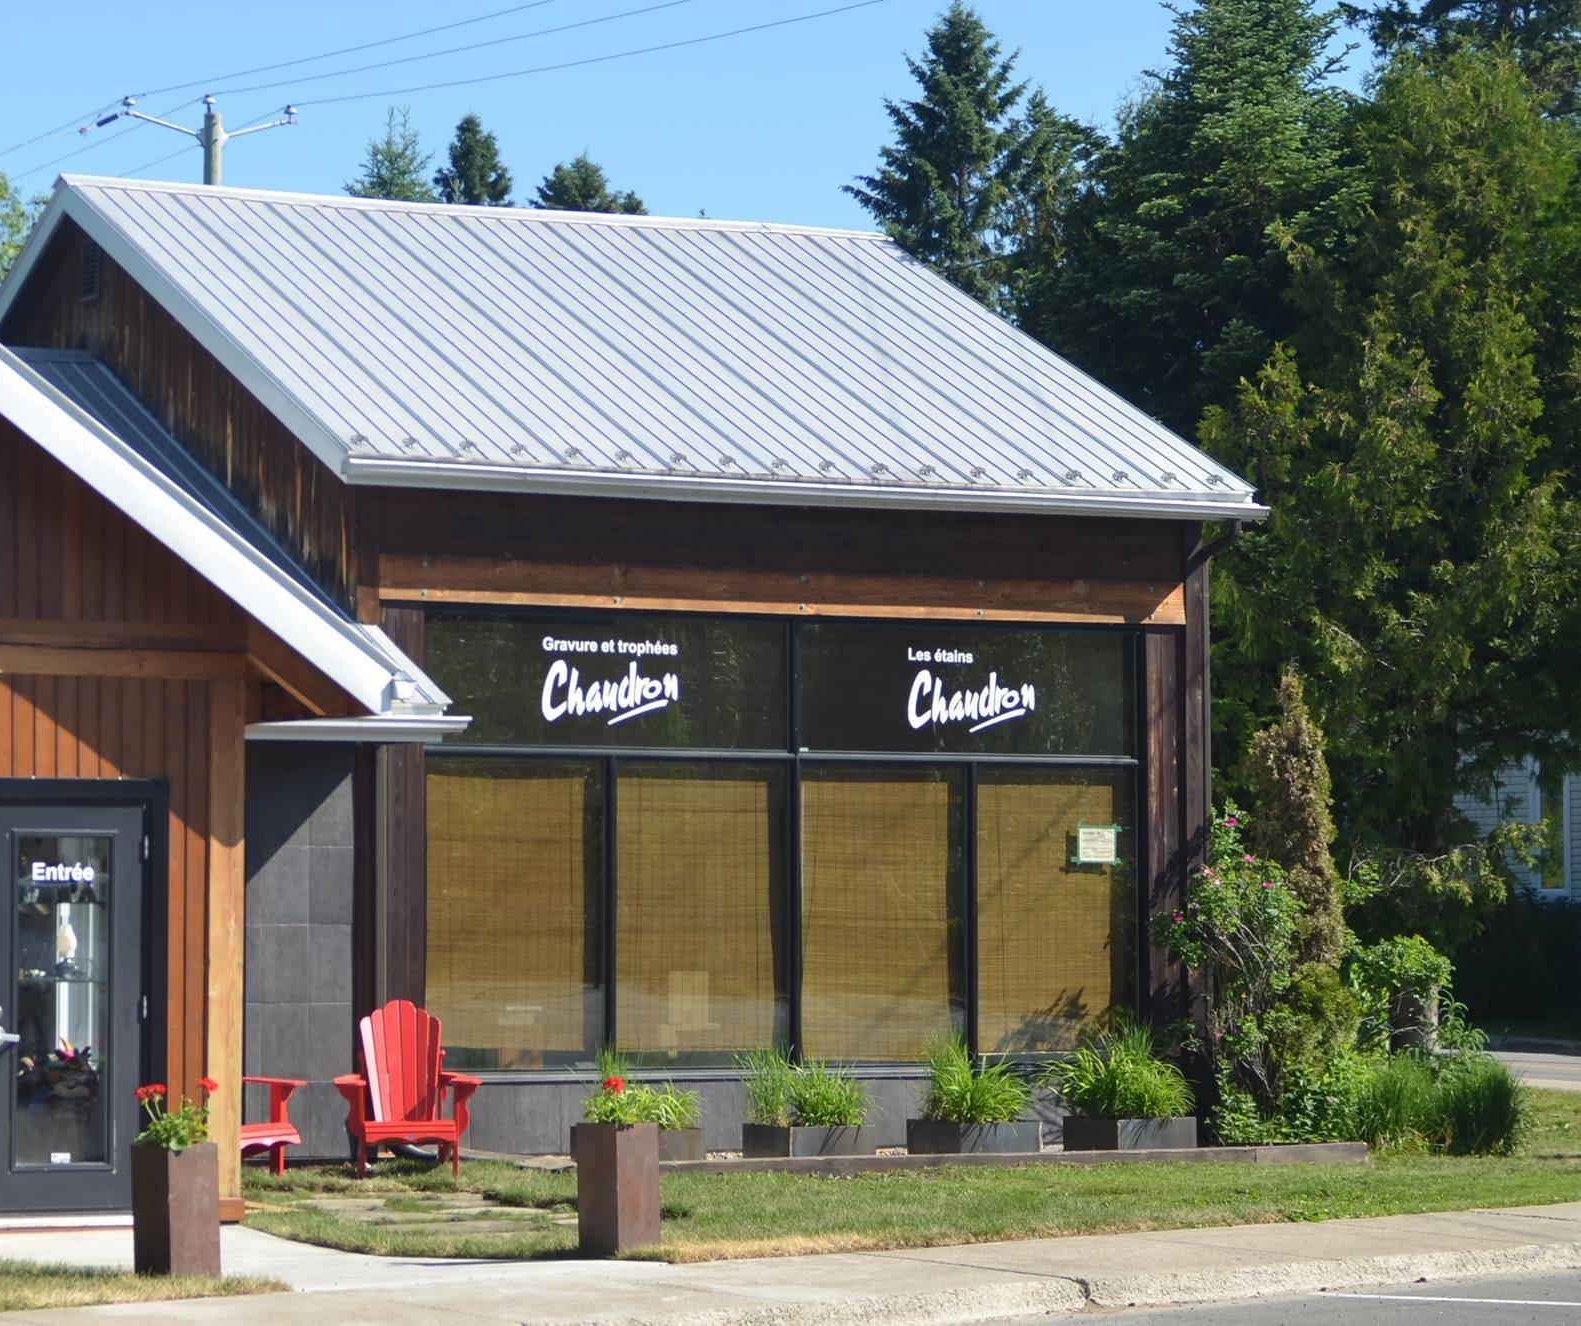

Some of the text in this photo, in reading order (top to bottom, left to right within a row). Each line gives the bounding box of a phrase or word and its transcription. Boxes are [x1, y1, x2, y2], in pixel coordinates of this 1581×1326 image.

[542, 636, 678, 656] Gravure et trophées
[908, 647, 973, 663] Les étains
[541, 659, 679, 722] Chaudron
[908, 669, 1036, 729] Chaudron
[32, 862, 96, 881] Entrée
